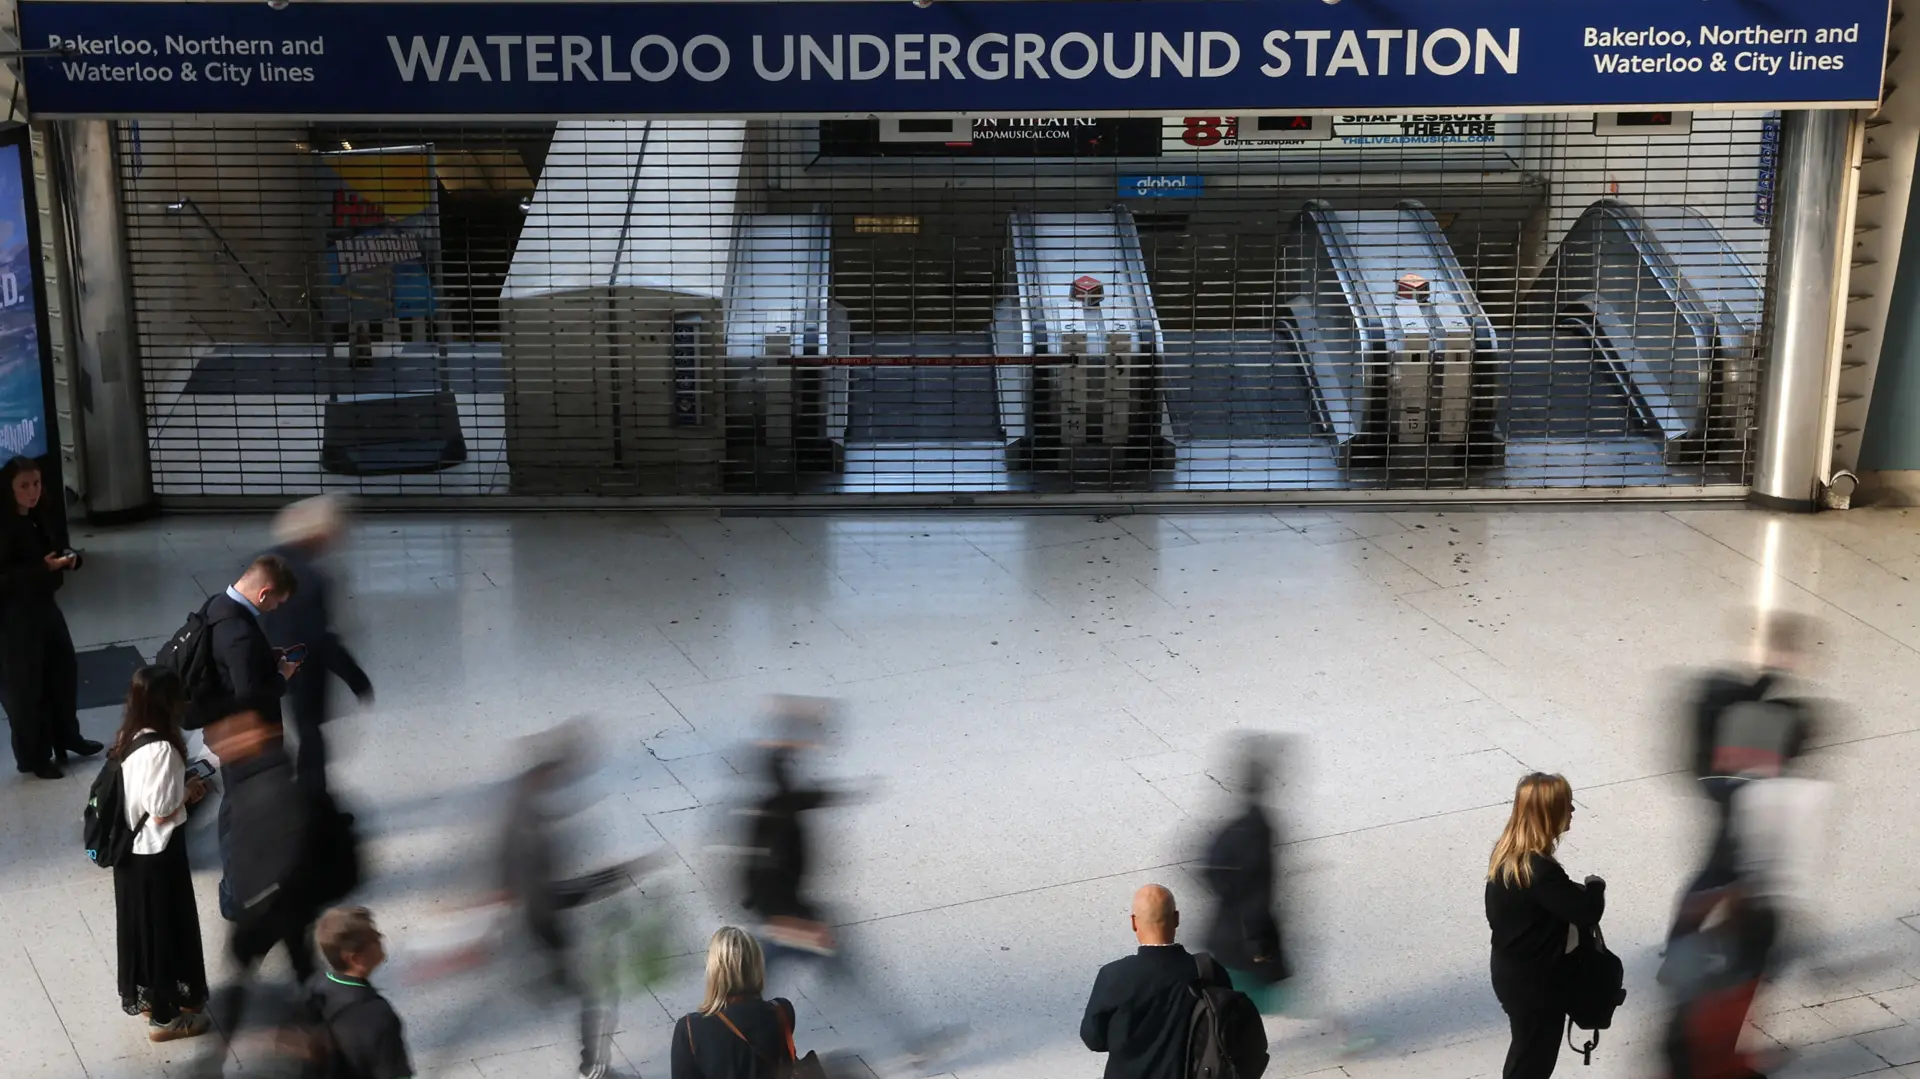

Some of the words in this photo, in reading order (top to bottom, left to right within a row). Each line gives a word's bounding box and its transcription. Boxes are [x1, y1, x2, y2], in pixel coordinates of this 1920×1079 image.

[165, 34, 274, 55] Northern
[281, 35, 325, 55] and
[1583, 26, 1692, 49] Bakerloo,
[1699, 25, 1808, 45] Northern
[1815, 23, 1859, 43] and
[387, 34, 731, 83] WATERLOO
[752, 31, 1240, 82] UNDERGROUND
[1260, 28, 1520, 78] STATION
[1593, 52, 1703, 73] Waterloo
[1710, 52, 1727, 72] &
[1734, 51, 1783, 76] City
[1789, 50, 1844, 71] lines
[62, 61, 173, 82] Waterloo
[180, 62, 198, 82] &
[204, 62, 252, 87] City
[260, 62, 315, 82] lines
[973, 129, 1070, 139] RADAMUSICAL.COM
[1400, 122, 1495, 136] THEATRE
[1341, 135, 1495, 145] THELIVEAIDMUSICAL.COM
[1136, 175, 1186, 196] global
